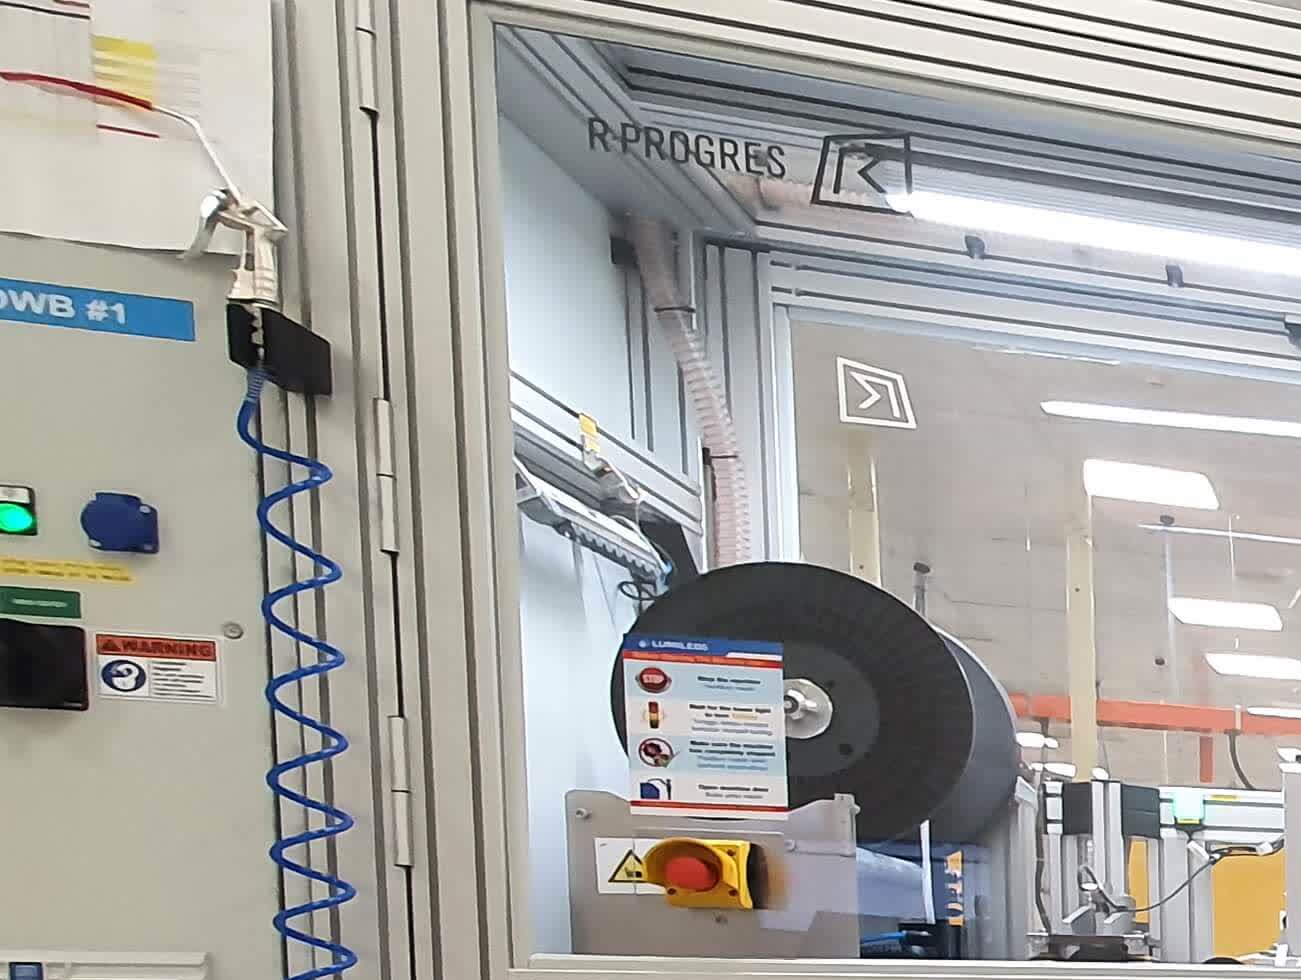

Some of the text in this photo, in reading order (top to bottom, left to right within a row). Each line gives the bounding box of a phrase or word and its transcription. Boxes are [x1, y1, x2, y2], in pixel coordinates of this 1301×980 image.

[0, 289, 126, 325] WB #1
[121, 640, 213, 657] WARNING
